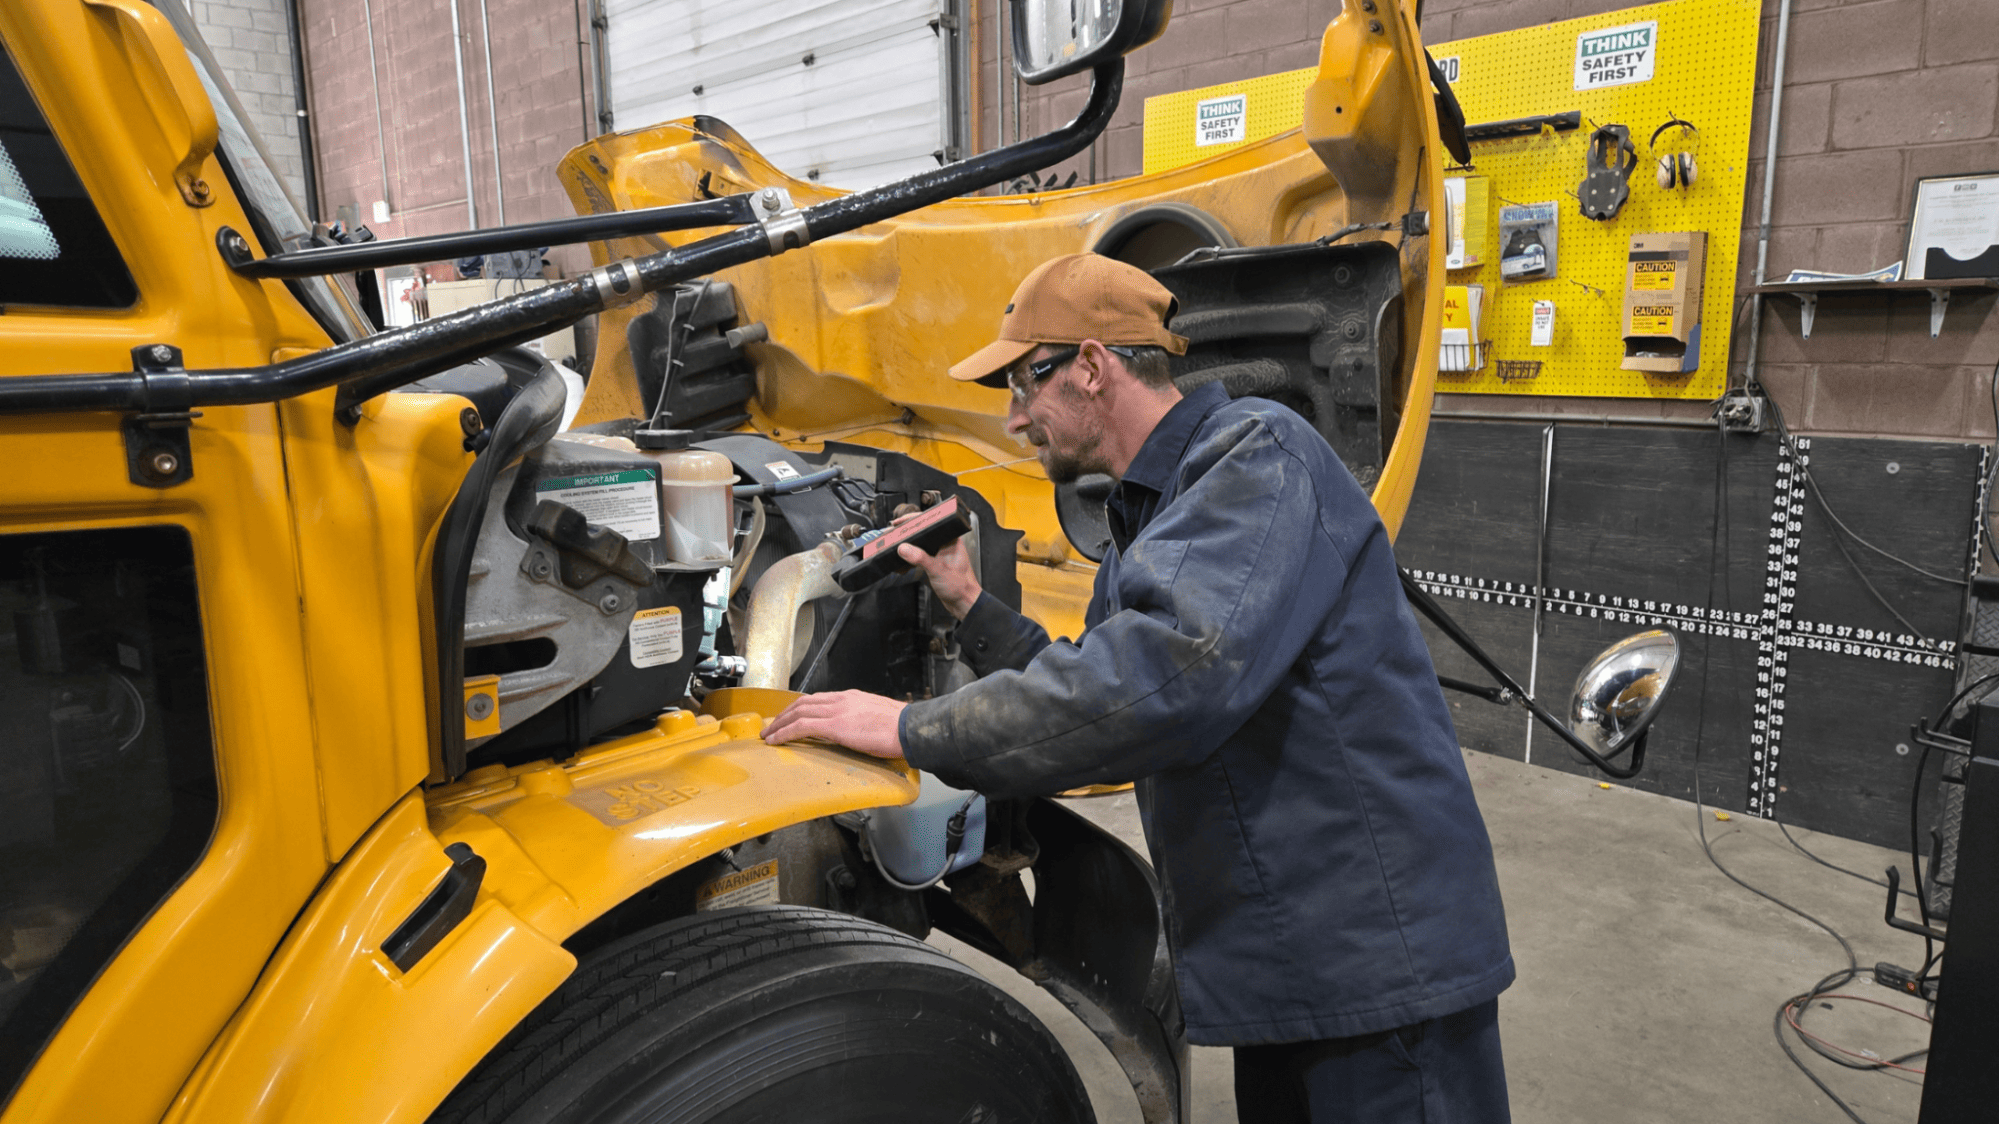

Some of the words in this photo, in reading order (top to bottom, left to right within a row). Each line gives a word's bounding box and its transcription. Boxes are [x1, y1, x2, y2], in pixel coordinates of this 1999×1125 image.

[1584, 30, 1647, 54] THINK
[1582, 50, 1646, 71] SAFETY
[1438, 58, 1458, 81] RD
[1589, 66, 1637, 83] FIRST
[1202, 101, 1240, 117] THINK
[1201, 116, 1240, 130] SAFETY
[1205, 128, 1235, 140] FIRST
[1636, 262, 1675, 272] CAUTION
[1445, 299, 1459, 309] AL
[1634, 306, 1673, 316] CAUTION
[1798, 439, 1810, 449] 51
[1777, 463, 1791, 473] 48
[575, 474, 619, 486] IMPORTANT
[1775, 479, 1788, 489] 45
[1792, 488, 1805, 499] 44
[1774, 496, 1787, 506] 43
[1790, 504, 1804, 515] 42
[1771, 512, 1785, 522] 40
[1788, 521, 1801, 532] 39
[1770, 528, 1784, 538] 38
[1786, 538, 1800, 549] 37
[1768, 544, 1782, 555] 36
[1785, 554, 1798, 565] 34
[1767, 561, 1781, 572] 33
[1783, 570, 1797, 581] 32
[1767, 577, 1778, 588] 31
[1413, 569, 1422, 578] 19
[1426, 572, 1434, 580] 17
[1438, 573, 1447, 582] 15
[1451, 575, 1460, 584] 13
[1464, 577, 1472, 586] 11
[1478, 578, 1484, 587] 9
[1493, 580, 1498, 590] 7
[1506, 582, 1511, 591] 5
[1520, 584, 1526, 593] 3
[1554, 588, 1560, 598] 3
[1569, 590, 1575, 600] 5
[1584, 593, 1590, 601] 7
[1599, 594, 1606, 604] 9
[1613, 596, 1622, 606] 11
[1628, 598, 1639, 609] 13
[1644, 600, 1656, 611] 15
[1660, 603, 1671, 613] 17
[1676, 605, 1688, 615] 19
[1692, 607, 1704, 617] 21
[1710, 609, 1723, 620] 23
[1744, 613, 1759, 624] 27
[1782, 587, 1795, 598] 30
[1764, 593, 1777, 604] 28
[1431, 585, 1440, 595] 16
[1443, 587, 1452, 596] 14
[1456, 589, 1465, 598] 12
[1469, 590, 1479, 600] 10
[1484, 593, 1490, 602] 8
[1497, 594, 1503, 604] 6
[1510, 597, 1516, 606] 4
[1525, 599, 1530, 608] 2
[1547, 602, 1552, 611] 2
[1560, 603, 1566, 613] 4
[1576, 605, 1582, 616] 6
[1591, 608, 1597, 618] 8
[1604, 610, 1615, 620] 10
[1619, 612, 1630, 622] 12
[1635, 614, 1646, 625] 14
[1681, 621, 1695, 632] 20
[1716, 625, 1730, 636] 24
[1733, 628, 1748, 639] 26
[1780, 602, 1794, 613] 27
[642, 610, 670, 618] ATTENTION
[1762, 609, 1776, 620] 26
[1778, 619, 1792, 630] 25
[1761, 625, 1774, 636] 24
[1797, 620, 1813, 632] 33
[1817, 623, 1833, 634] 35
[1837, 625, 1852, 637] 37
[1856, 627, 1873, 640] 39
[1876, 631, 1891, 643] 41
[1896, 633, 1914, 646] 43
[1938, 639, 1956, 652] 47
[1777, 635, 1790, 646] 23
[1759, 641, 1772, 652] 22
[1790, 636, 1804, 647] 32
[1807, 637, 1823, 650] 34
[1824, 640, 1840, 652] 36
[1844, 643, 1860, 655] 38
[1863, 646, 1881, 658] 40
[1883, 648, 1900, 662] 42
[1904, 652, 1921, 665] 44
[1924, 655, 1940, 667] 46
[1758, 656, 1771, 667] 20
[1776, 651, 1787, 662] 21
[1758, 672, 1769, 682] 18
[1775, 667, 1786, 677] 19
[1756, 687, 1768, 698] 16
[1774, 683, 1785, 693] 17
[1754, 703, 1766, 714] 14
[1772, 699, 1784, 710] 15
[1754, 719, 1766, 730] 12
[1771, 714, 1783, 725] 13
[1751, 734, 1763, 745] 10
[1770, 730, 1780, 740] 11
[1754, 751, 1762, 761] 8
[1771, 745, 1779, 756] 9
[1770, 761, 1777, 771] 7
[1751, 782, 1758, 791] 4
[1768, 777, 1776, 787] 5
[604, 779, 665, 801] NO
[607, 785, 701, 820] STEP
[1750, 797, 1758, 807] 2
[1768, 792, 1775, 803] 3
[1767, 807, 1772, 817] 1
[713, 865, 770, 893] WARNING
